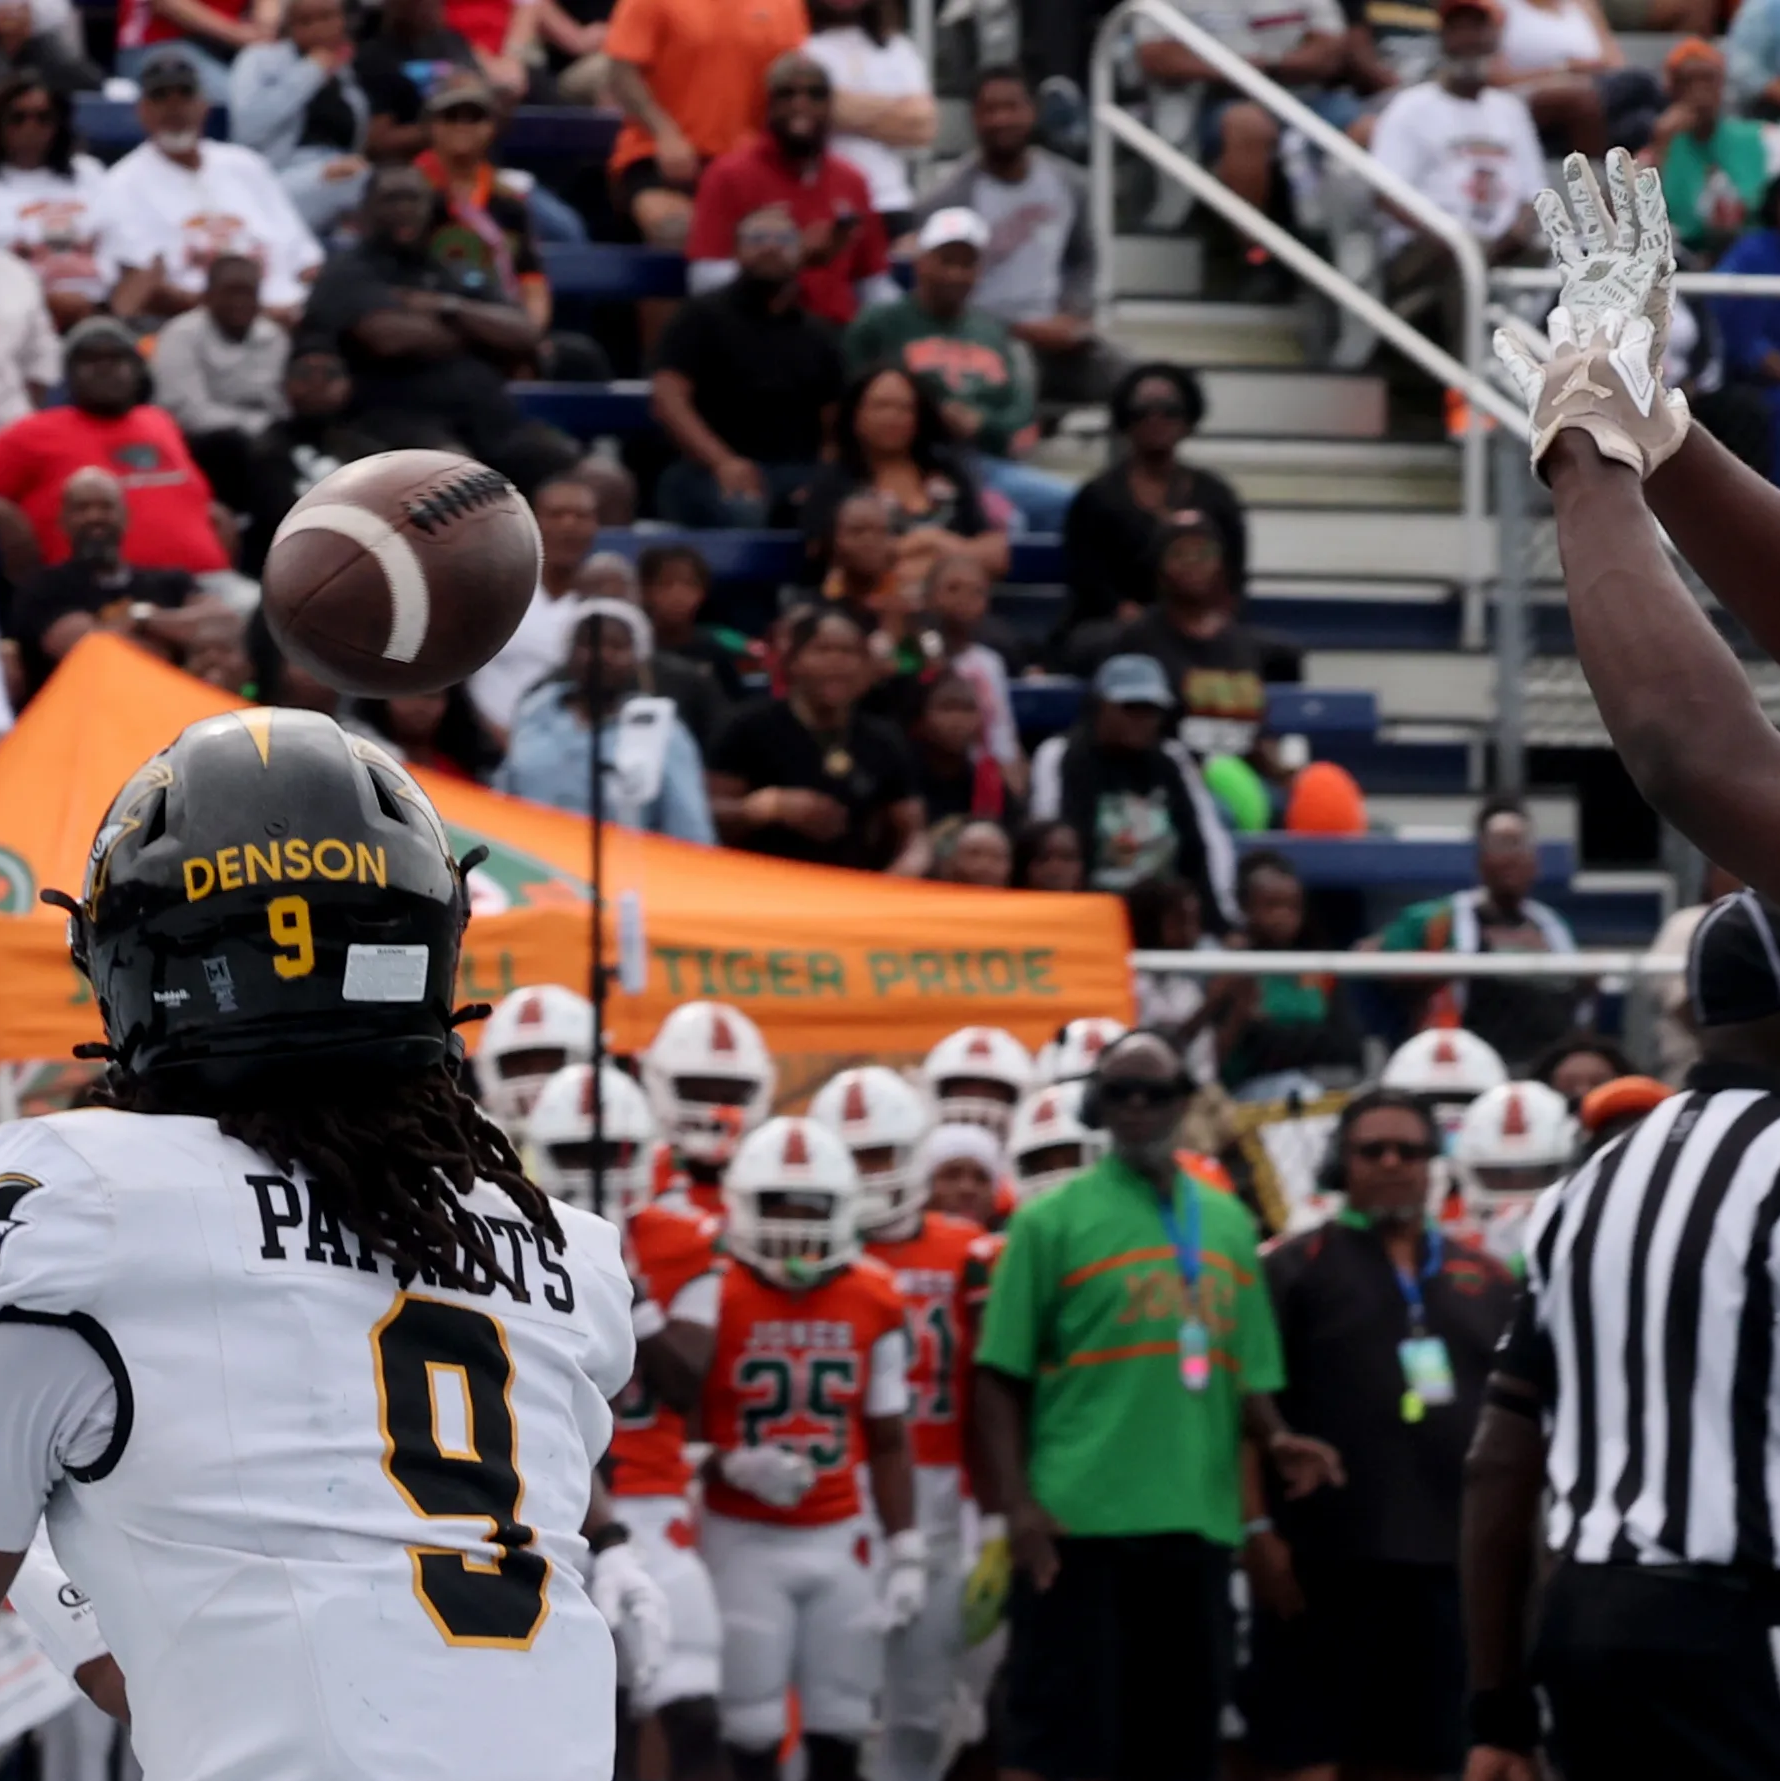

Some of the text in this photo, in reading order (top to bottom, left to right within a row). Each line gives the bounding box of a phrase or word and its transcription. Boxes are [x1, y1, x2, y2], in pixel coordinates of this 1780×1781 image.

[182, 837, 388, 904] DENSON
[266, 894, 316, 980] 9
[653, 946, 1061, 996] TIGER PRIDE
[734, 1350, 860, 1470] 25
[368, 1289, 551, 1652] 9
